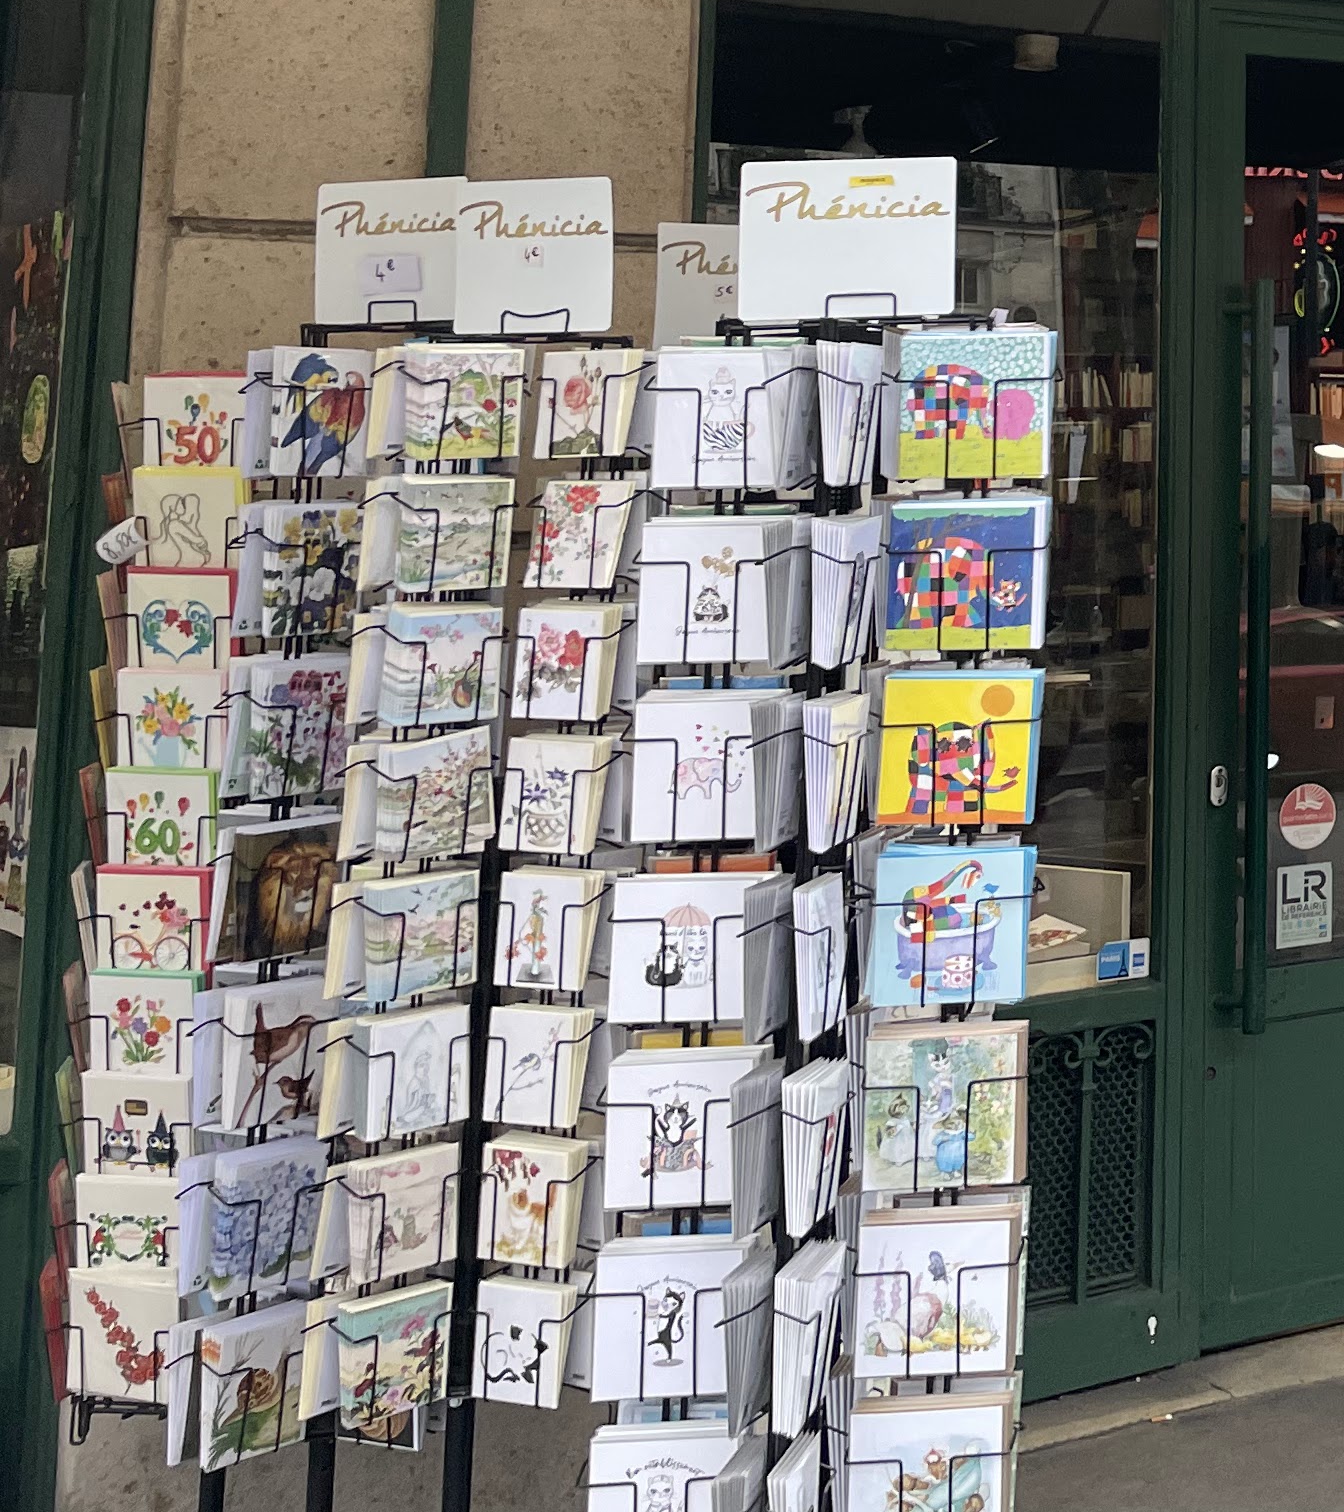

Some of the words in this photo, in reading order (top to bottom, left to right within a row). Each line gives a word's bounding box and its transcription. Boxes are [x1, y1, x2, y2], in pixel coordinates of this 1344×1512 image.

[321, 199, 456, 239] Phénicia
[459, 199, 609, 240] Phénicia
[746, 181, 951, 223] Phénicia
[173, 425, 221, 465] 50
[135, 818, 182, 857] 60
